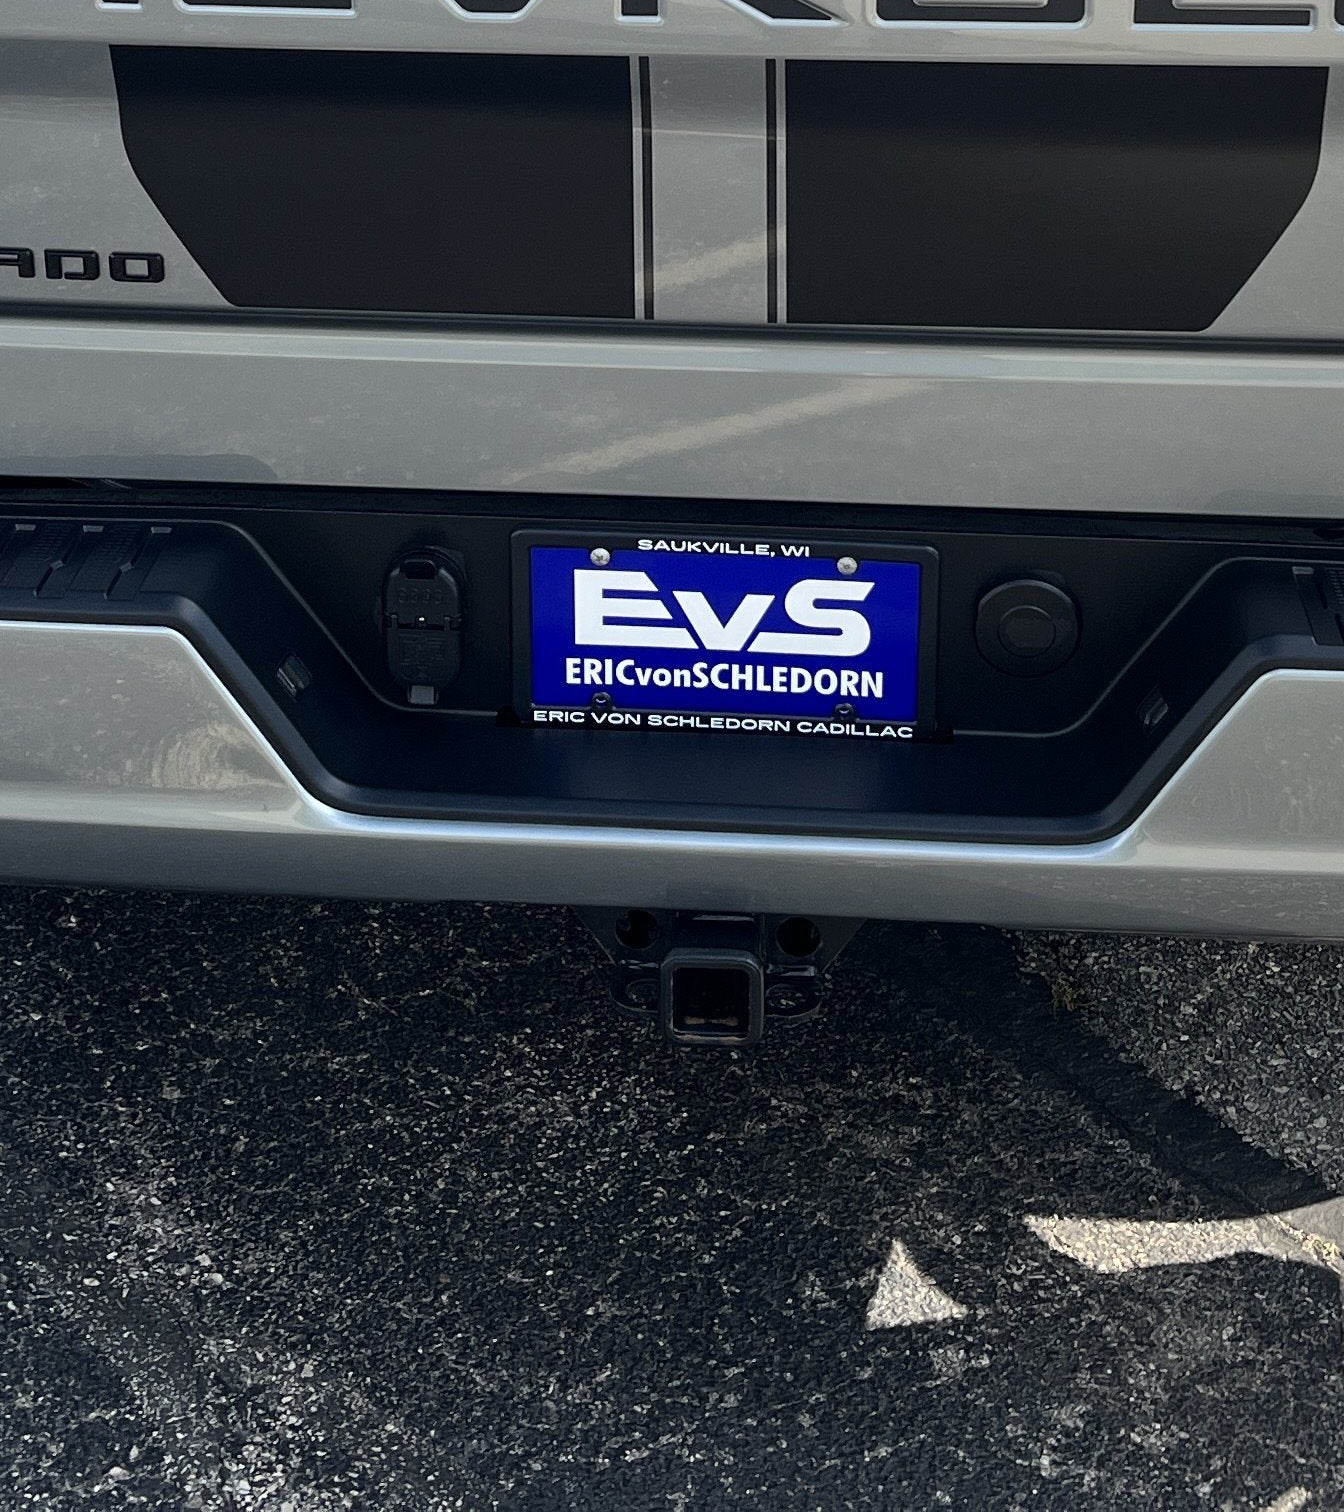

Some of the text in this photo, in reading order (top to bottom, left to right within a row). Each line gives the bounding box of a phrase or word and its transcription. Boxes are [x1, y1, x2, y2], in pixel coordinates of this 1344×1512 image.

[637, 539, 810, 558] SAUKVILLE, WI
[573, 568, 875, 657] EvS
[565, 657, 884, 699] ERICvonSCHLEDORN
[533, 710, 913, 739] ERIC VON SCHLEDORN CADILLAC
